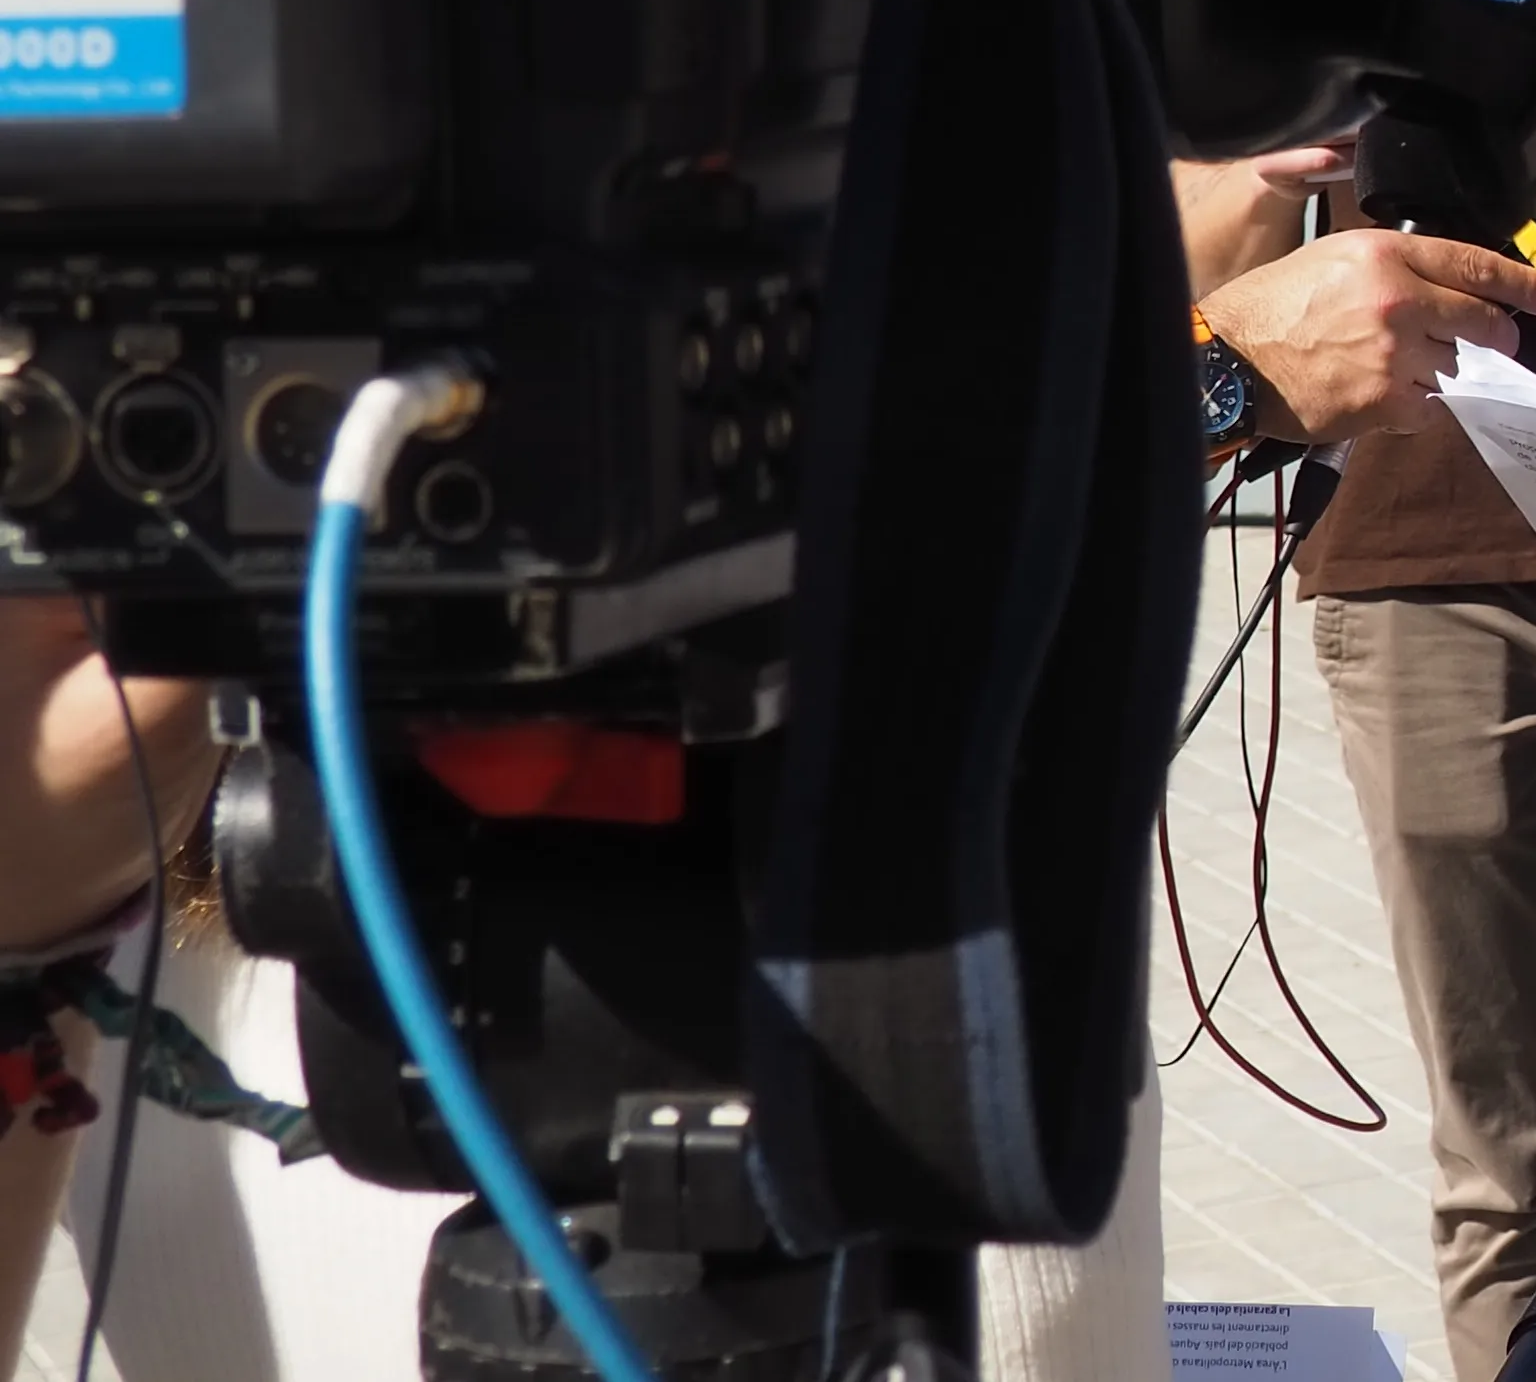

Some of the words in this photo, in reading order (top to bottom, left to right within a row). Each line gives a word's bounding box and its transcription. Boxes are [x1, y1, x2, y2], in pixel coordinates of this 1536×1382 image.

[1175, 1303, 1209, 1316] cabals
[1210, 1304, 1231, 1317] dels
[1233, 1304, 1278, 1318] garantia
[1279, 1306, 1291, 1318] La
[1172, 1321, 1210, 1332] masses
[1211, 1321, 1226, 1333] les
[1227, 1322, 1290, 1336] directament
[1227, 1339, 1244, 1352] del
[1244, 1340, 1289, 1352] població
[1181, 1357, 1253, 1370] Metropolitana
